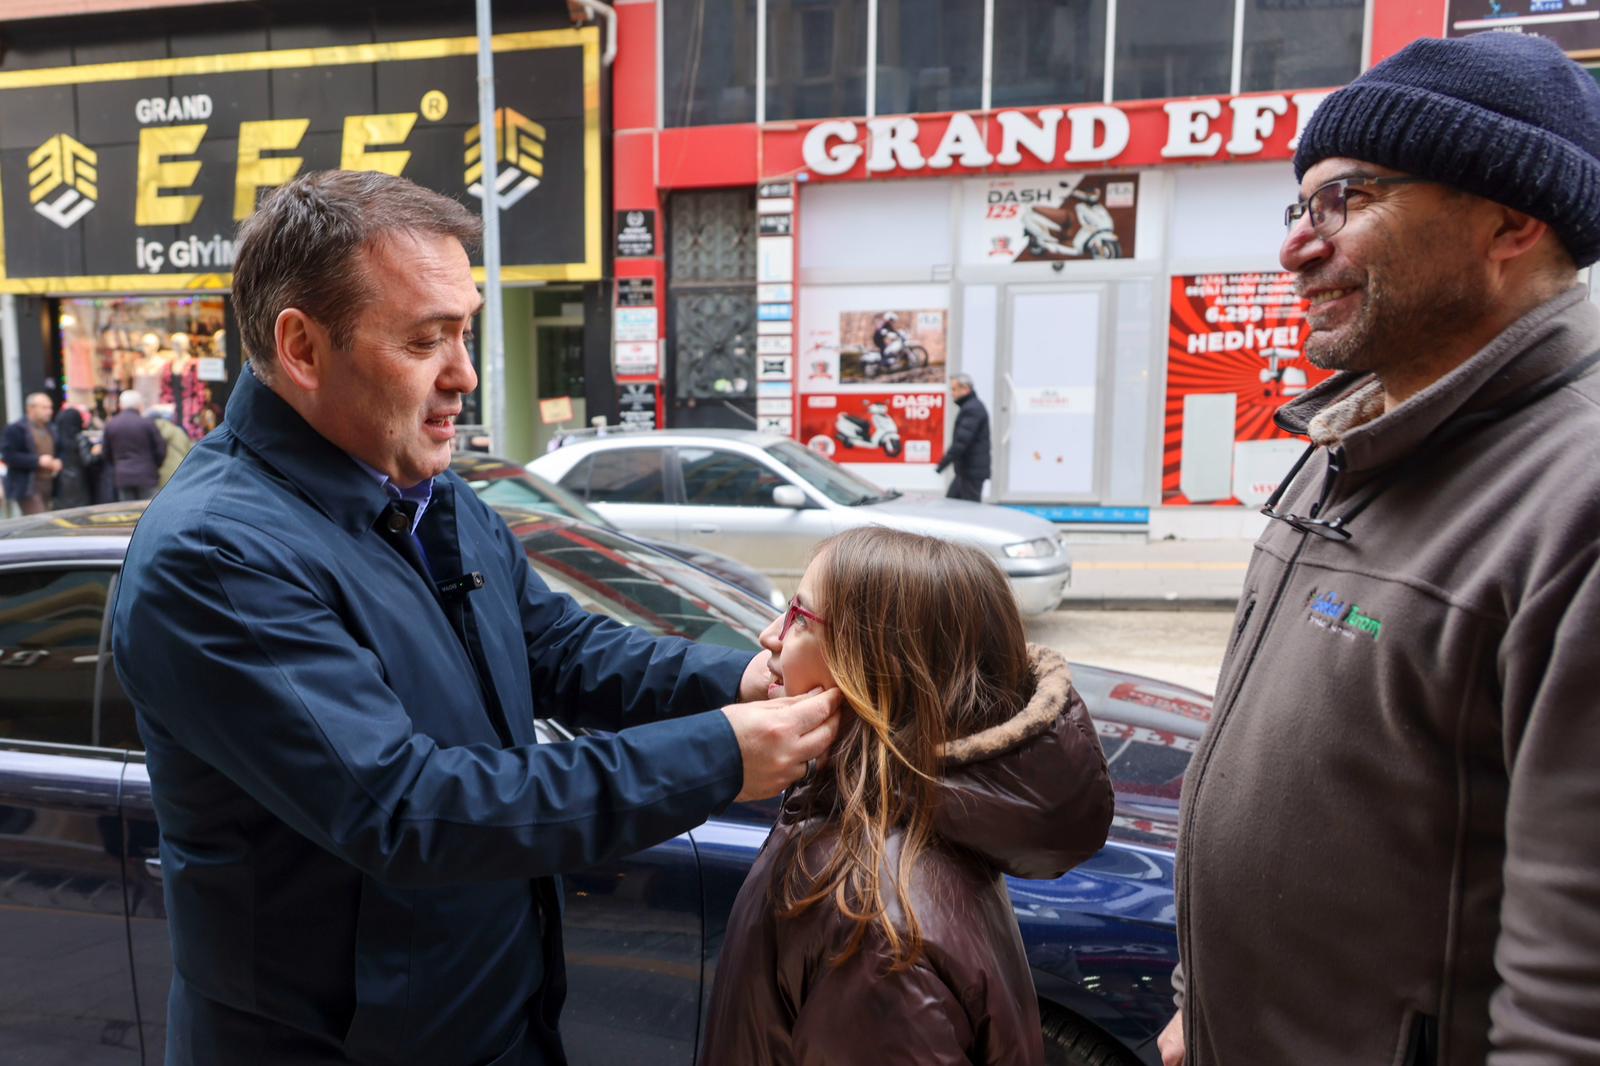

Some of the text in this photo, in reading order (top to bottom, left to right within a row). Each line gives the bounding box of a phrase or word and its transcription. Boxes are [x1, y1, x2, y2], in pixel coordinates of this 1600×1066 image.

[136, 94, 213, 124] GRAND
[802, 106, 1130, 176] GRAND
[987, 189, 1052, 205] DASH
[985, 204, 1019, 219] 125
[136, 237, 165, 273] İÇ
[1205, 305, 1263, 323] 6.299
[1187, 323, 1299, 354] HEDİYE!
[892, 395, 943, 409] DASH
[905, 406, 930, 420] 110
